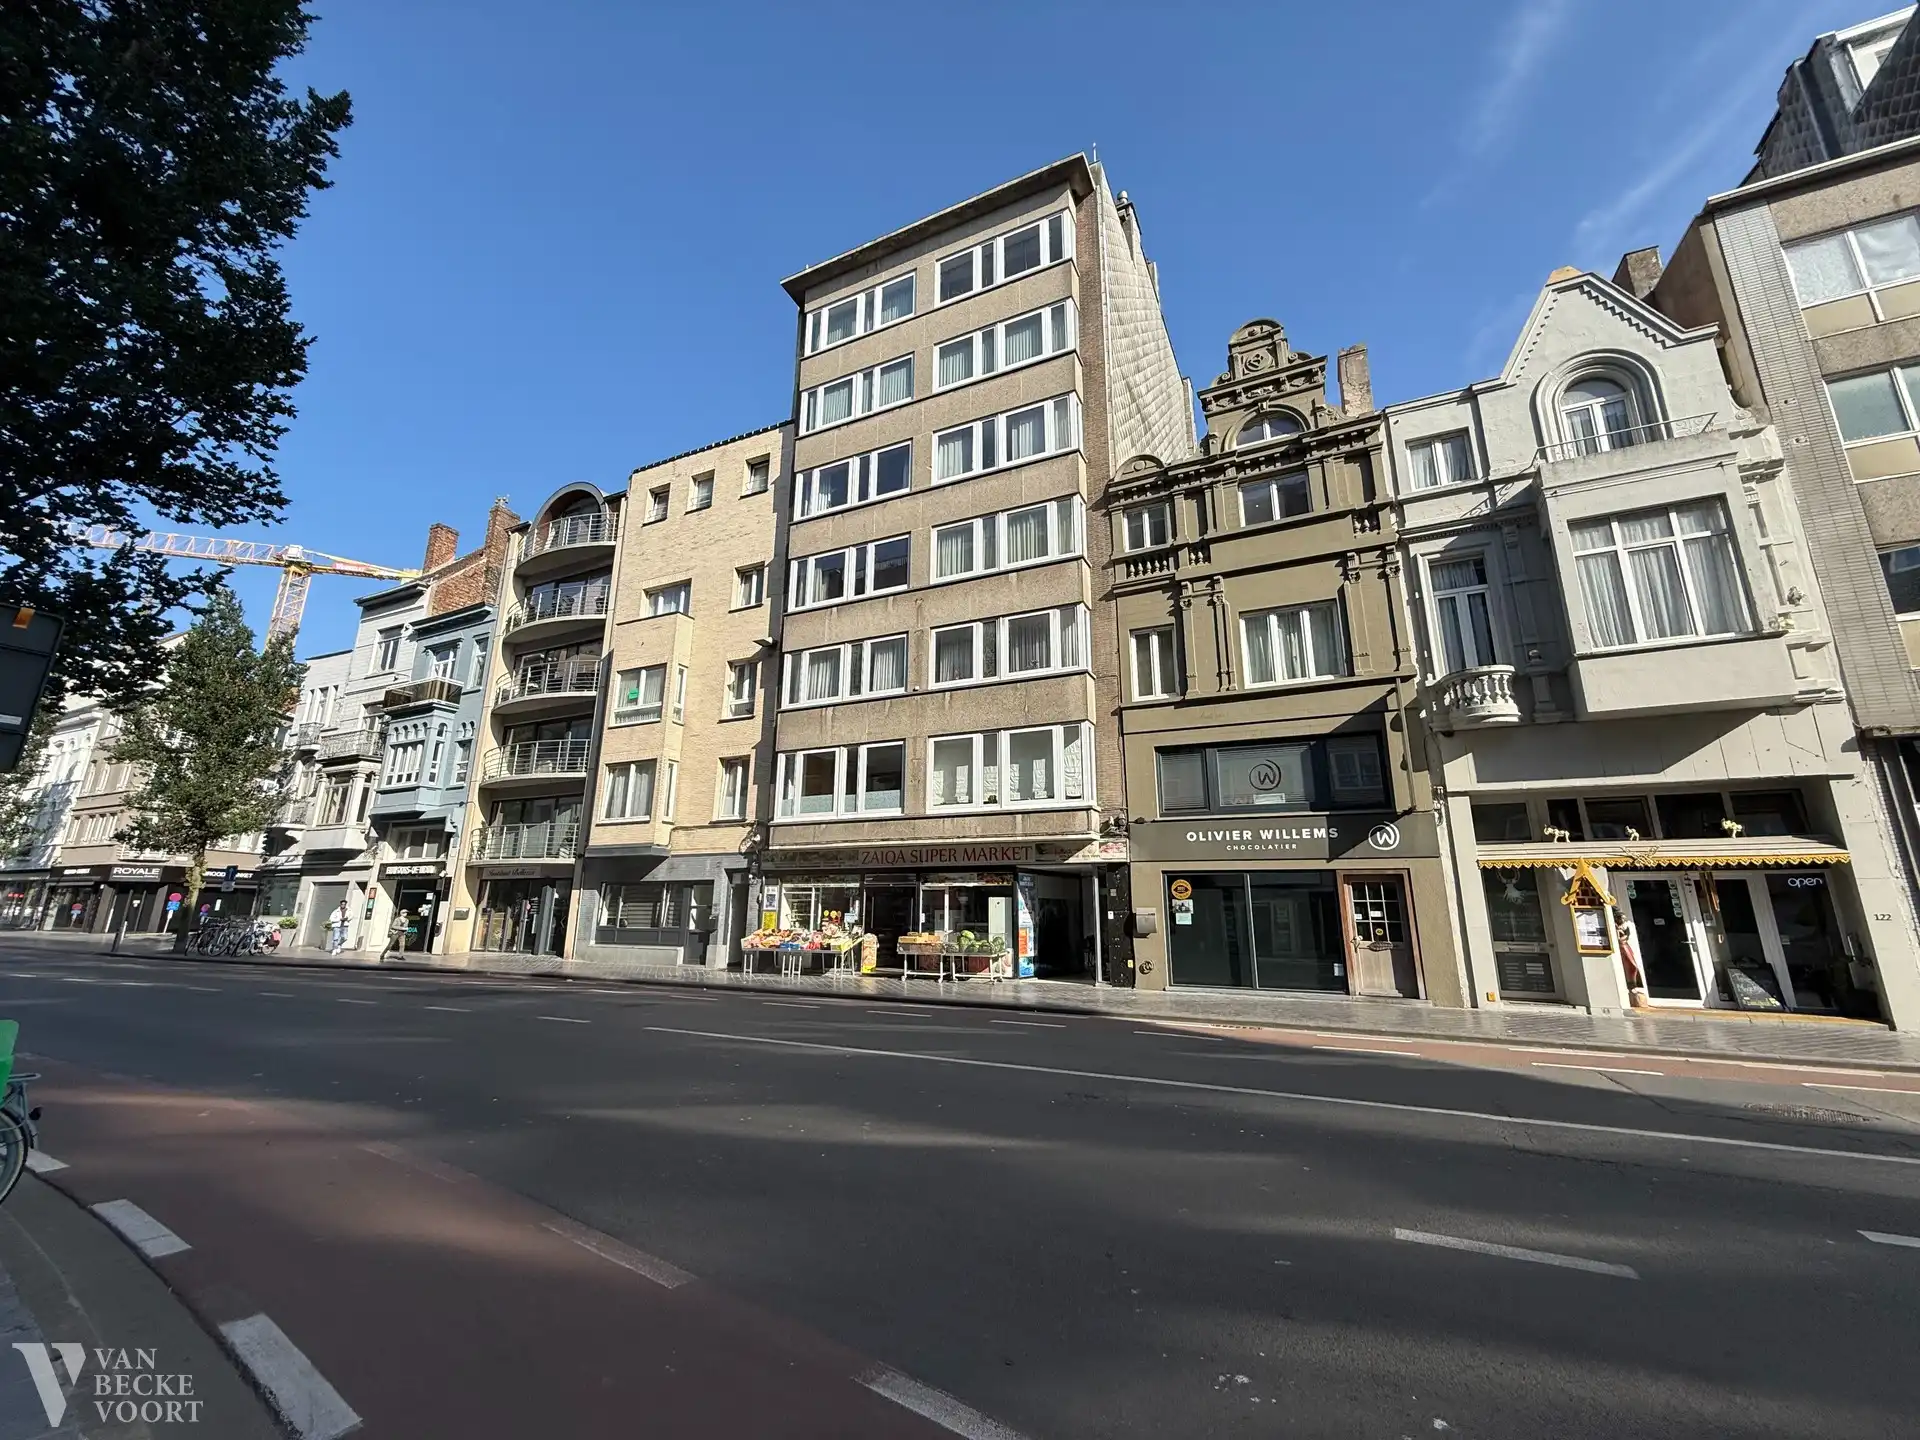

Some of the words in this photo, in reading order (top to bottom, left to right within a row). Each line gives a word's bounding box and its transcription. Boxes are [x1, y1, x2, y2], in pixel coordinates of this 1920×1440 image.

[1186, 829, 1253, 842] OLIVIER
[1259, 827, 1339, 840] WILLEMS
[1226, 843, 1298, 851] CHOCOLATIER
[861, 849, 906, 865] ZAIQA
[910, 848, 958, 864] SUPER
[962, 845, 1033, 862] MARKET
[113, 867, 161, 875] ROYALE
[1787, 877, 1823, 888] open
[1873, 913, 1893, 921] 122
